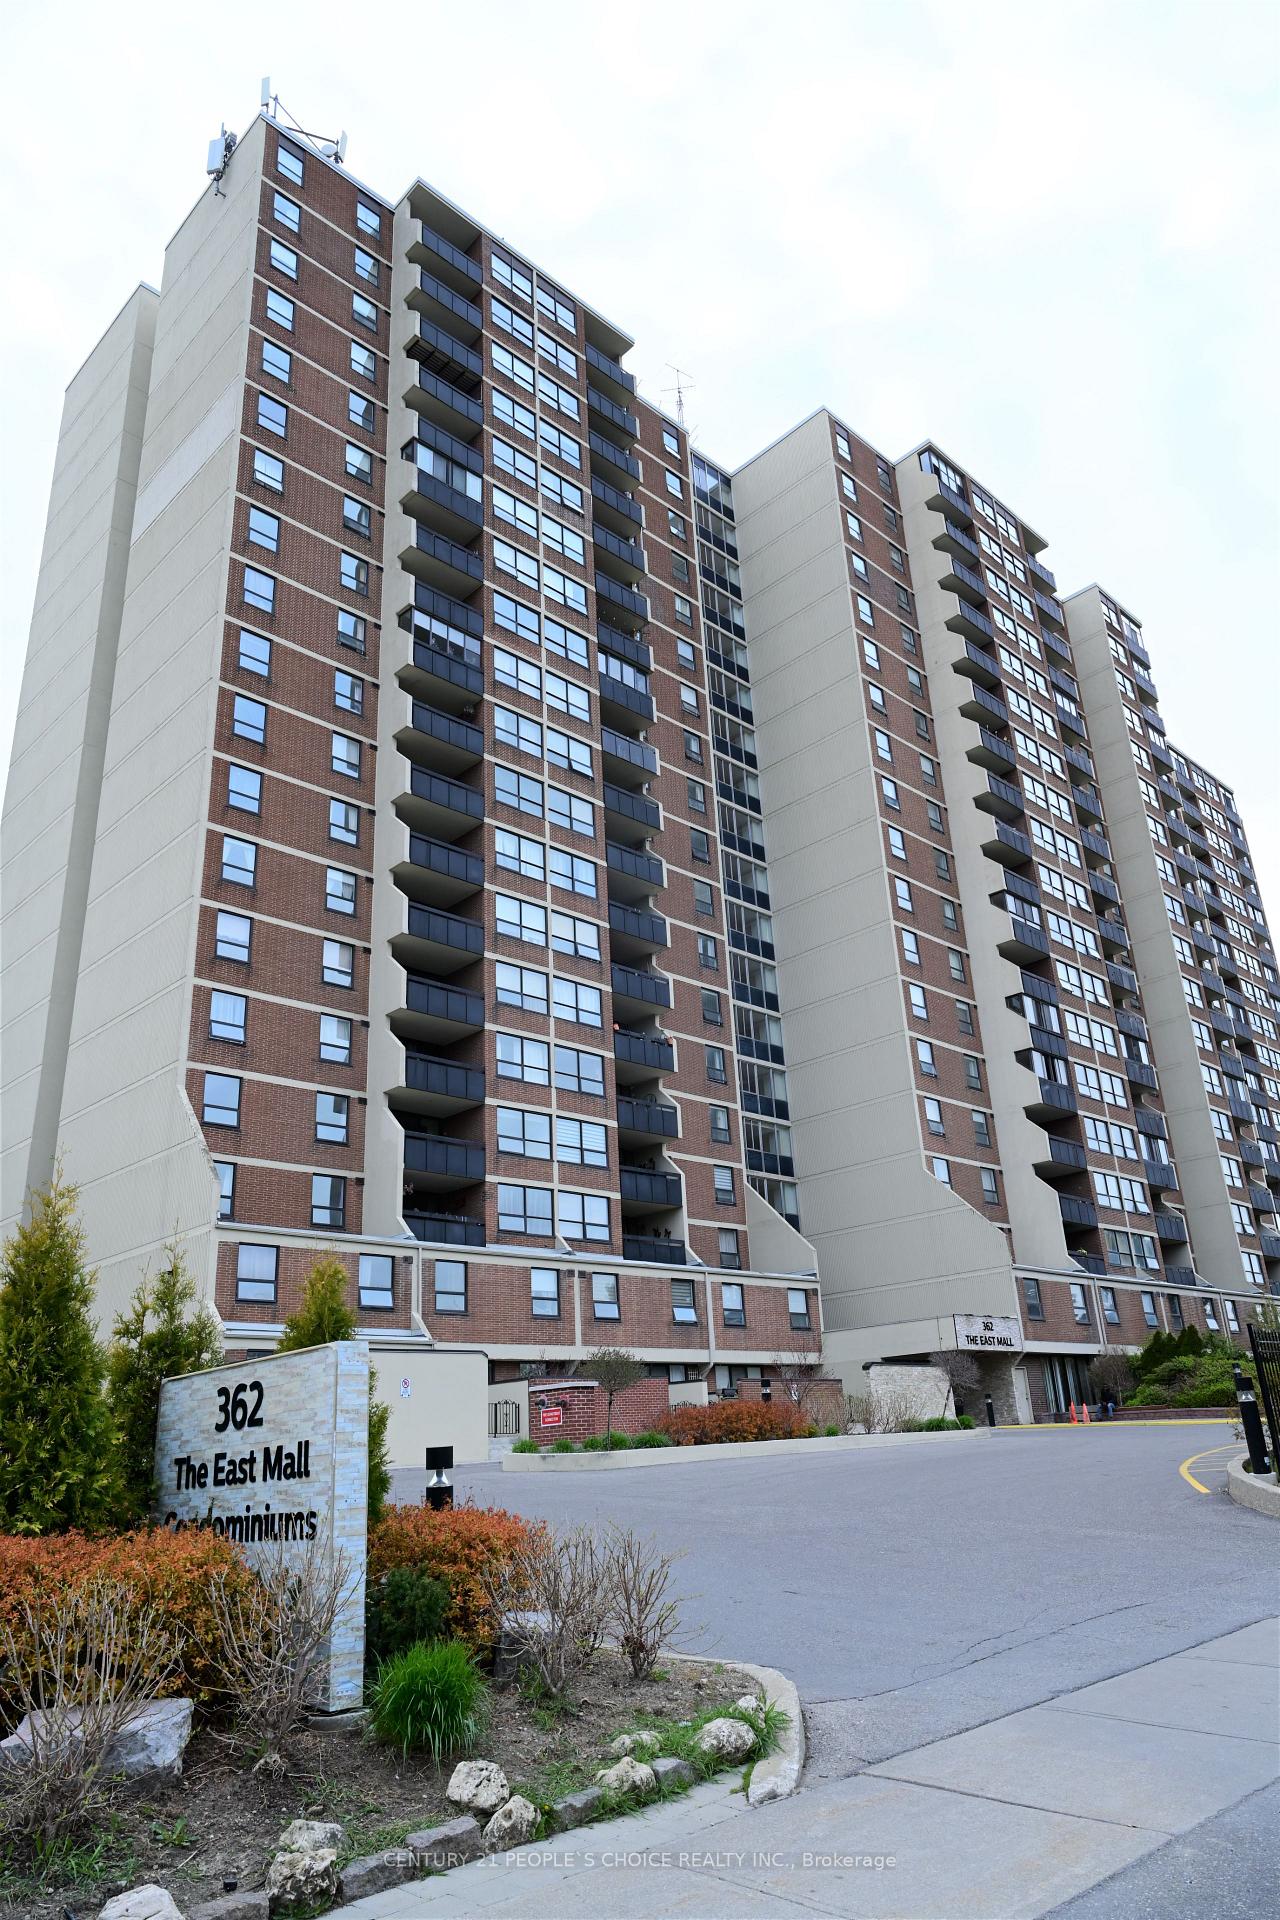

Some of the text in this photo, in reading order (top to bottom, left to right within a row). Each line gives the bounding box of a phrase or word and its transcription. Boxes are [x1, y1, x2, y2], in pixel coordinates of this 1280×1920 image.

[965, 1335, 1014, 1347] THE EAST MALL
[982, 1321, 994, 1331] 362
[215, 1381, 264, 1432] 362
[174, 1440, 310, 1490] The East Mall
